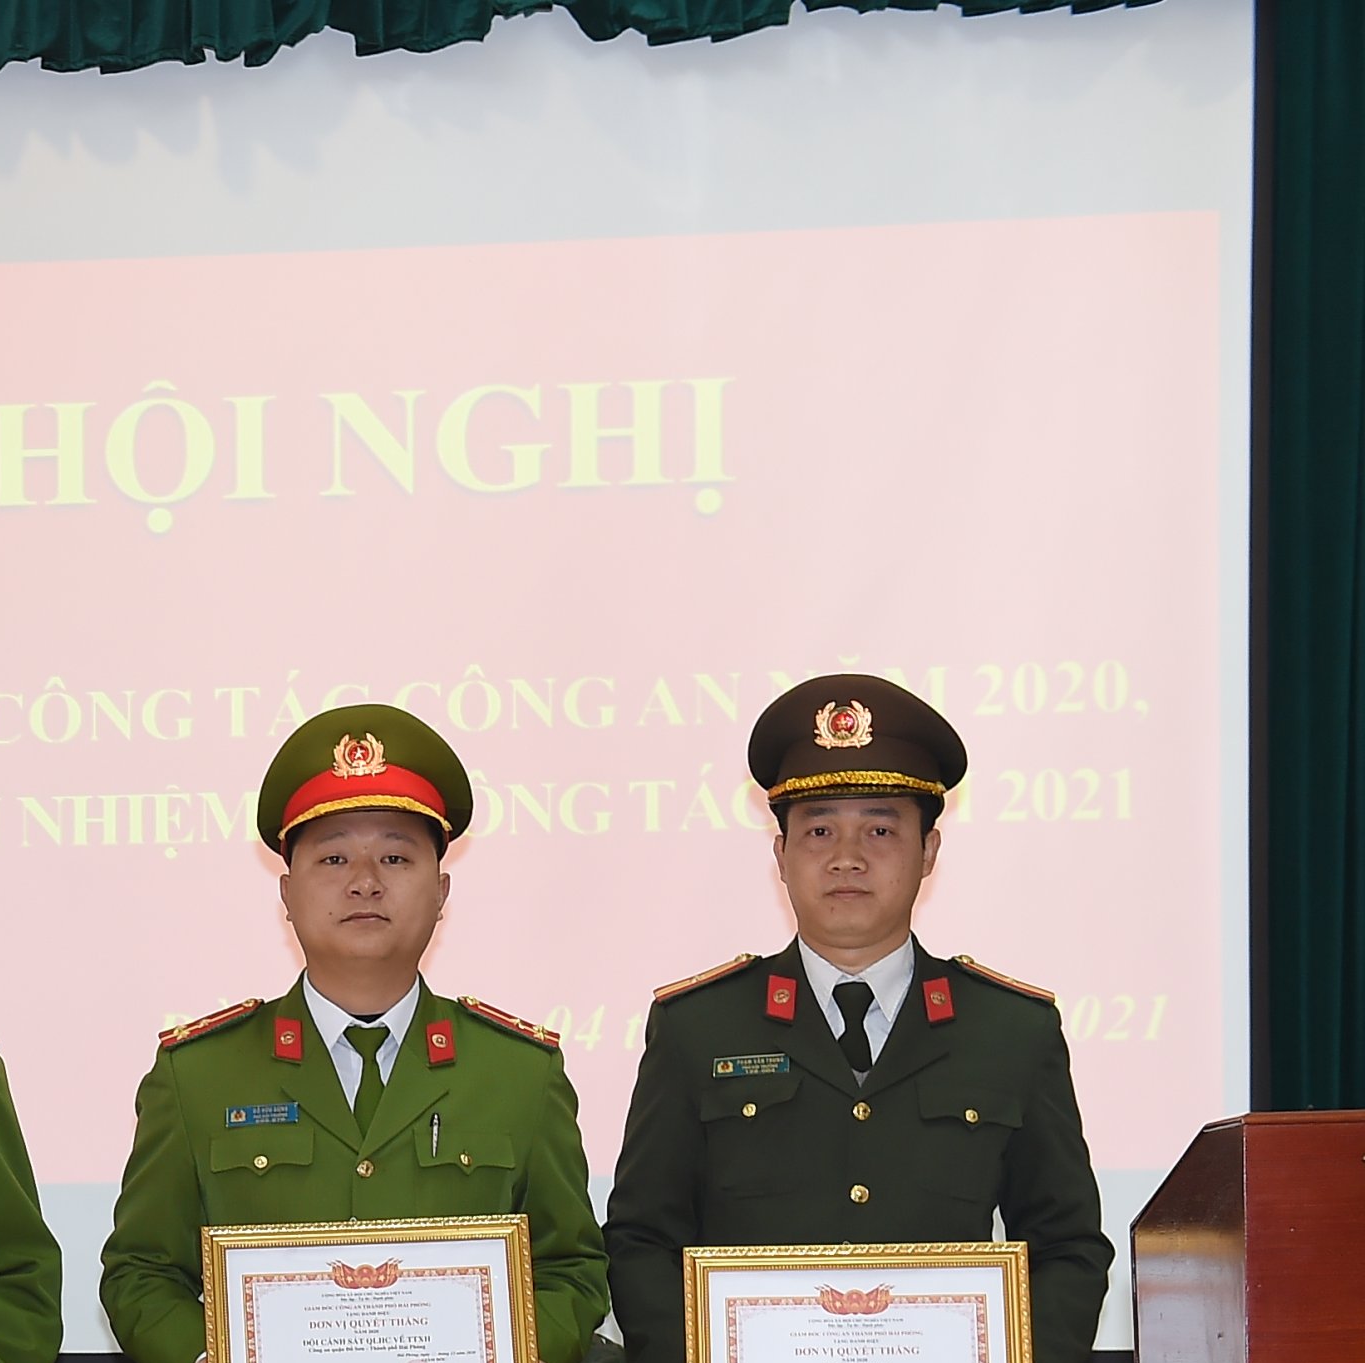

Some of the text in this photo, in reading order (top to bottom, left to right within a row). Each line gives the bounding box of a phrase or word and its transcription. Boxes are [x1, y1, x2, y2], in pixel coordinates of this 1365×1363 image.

[318, 376, 736, 515] NGHỊ
[636, 672, 740, 730] AN
[973, 660, 1149, 722] 2020,
[17, 784, 260, 860] NHIỆM
[467, 768, 614, 838] ÔNG
[628, 759, 770, 833] TÁC
[985, 766, 1137, 823] 2021
[1055, 994, 1170, 1041] 021
